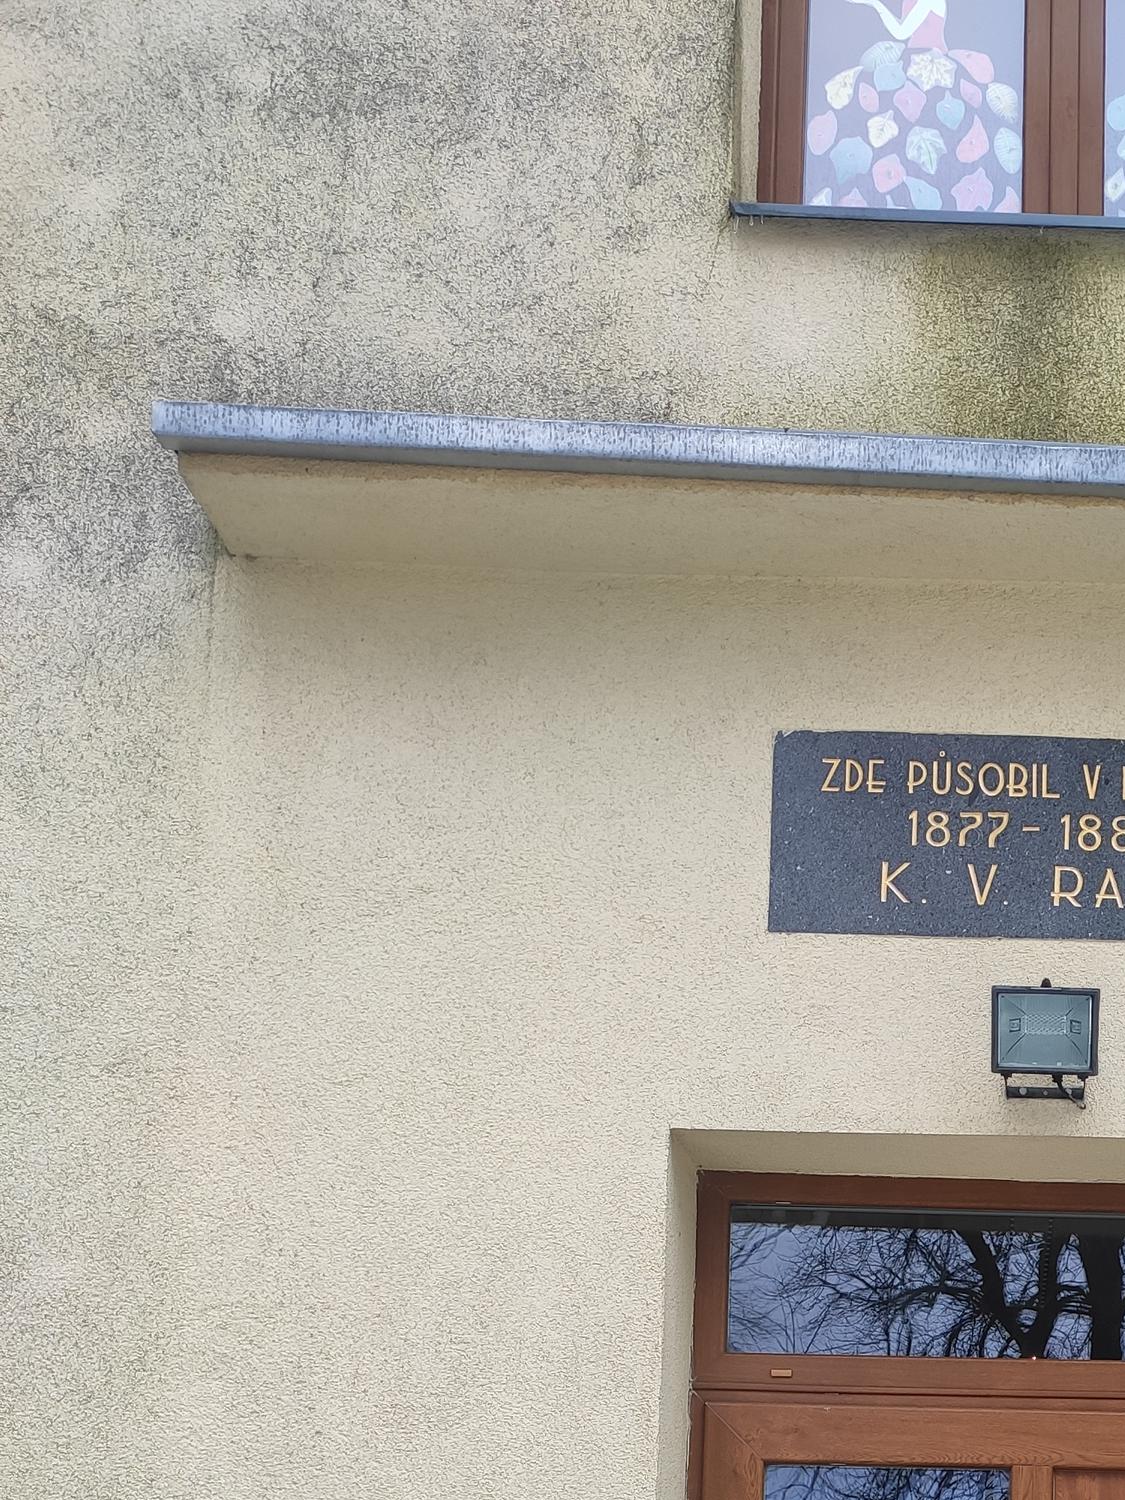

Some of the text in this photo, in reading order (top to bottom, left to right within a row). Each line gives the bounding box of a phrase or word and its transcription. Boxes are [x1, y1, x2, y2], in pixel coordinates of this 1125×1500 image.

[821, 758, 886, 793] ZDE
[906, 751, 1060, 799] PŮSOBIL
[1083, 765, 1101, 800] V
[908, 810, 1010, 848] 1877
